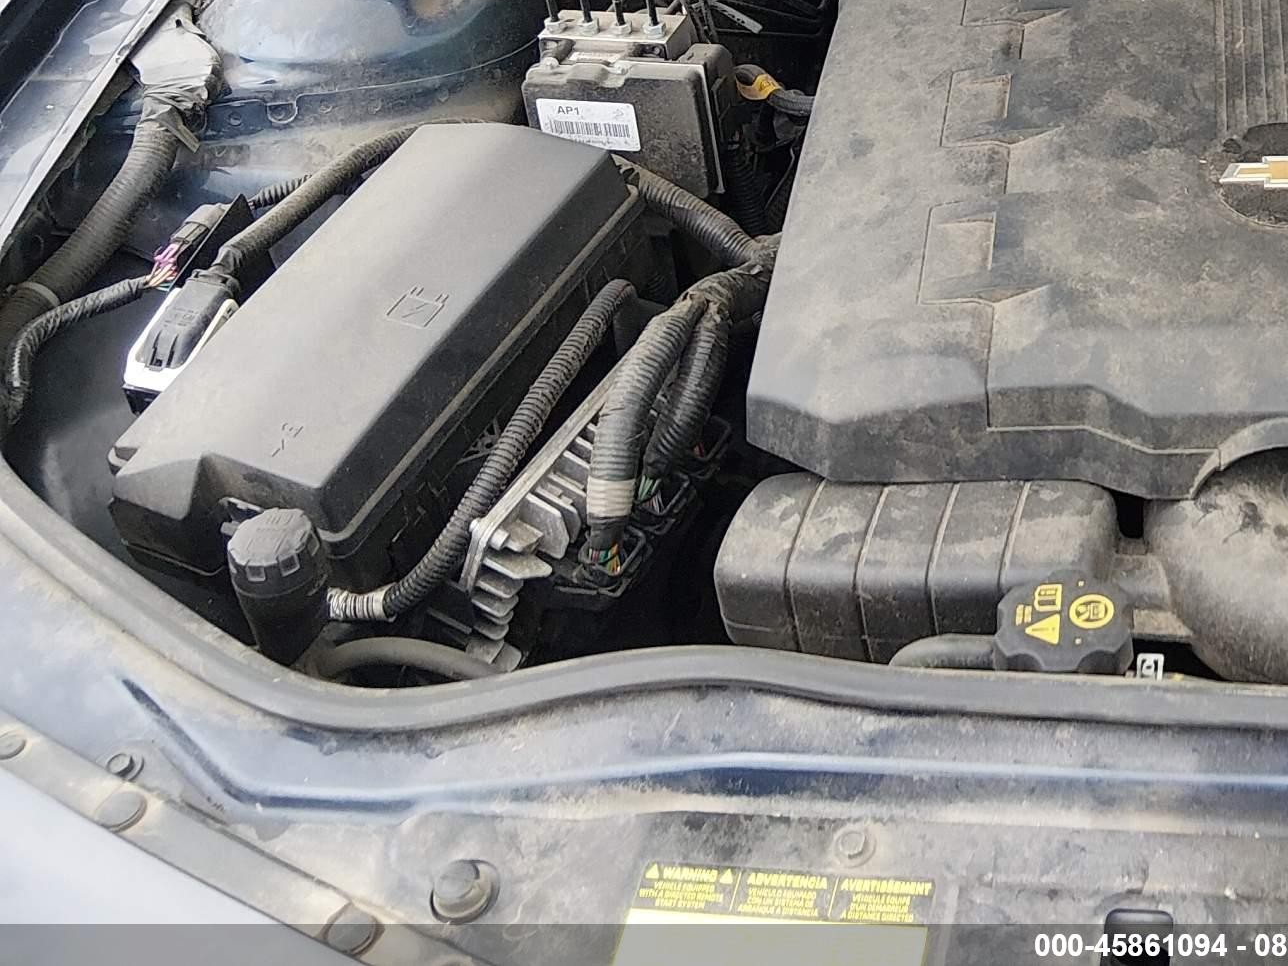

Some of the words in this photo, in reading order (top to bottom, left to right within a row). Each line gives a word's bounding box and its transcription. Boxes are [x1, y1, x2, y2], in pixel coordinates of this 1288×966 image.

[557, 105, 580, 116] AP1
[663, 866, 719, 883] WARNING
[746, 872, 828, 890] ADVERTENCIA
[840, 878, 932, 896] AVERTISSEMENT
[677, 899, 706, 909] SYSTEM
